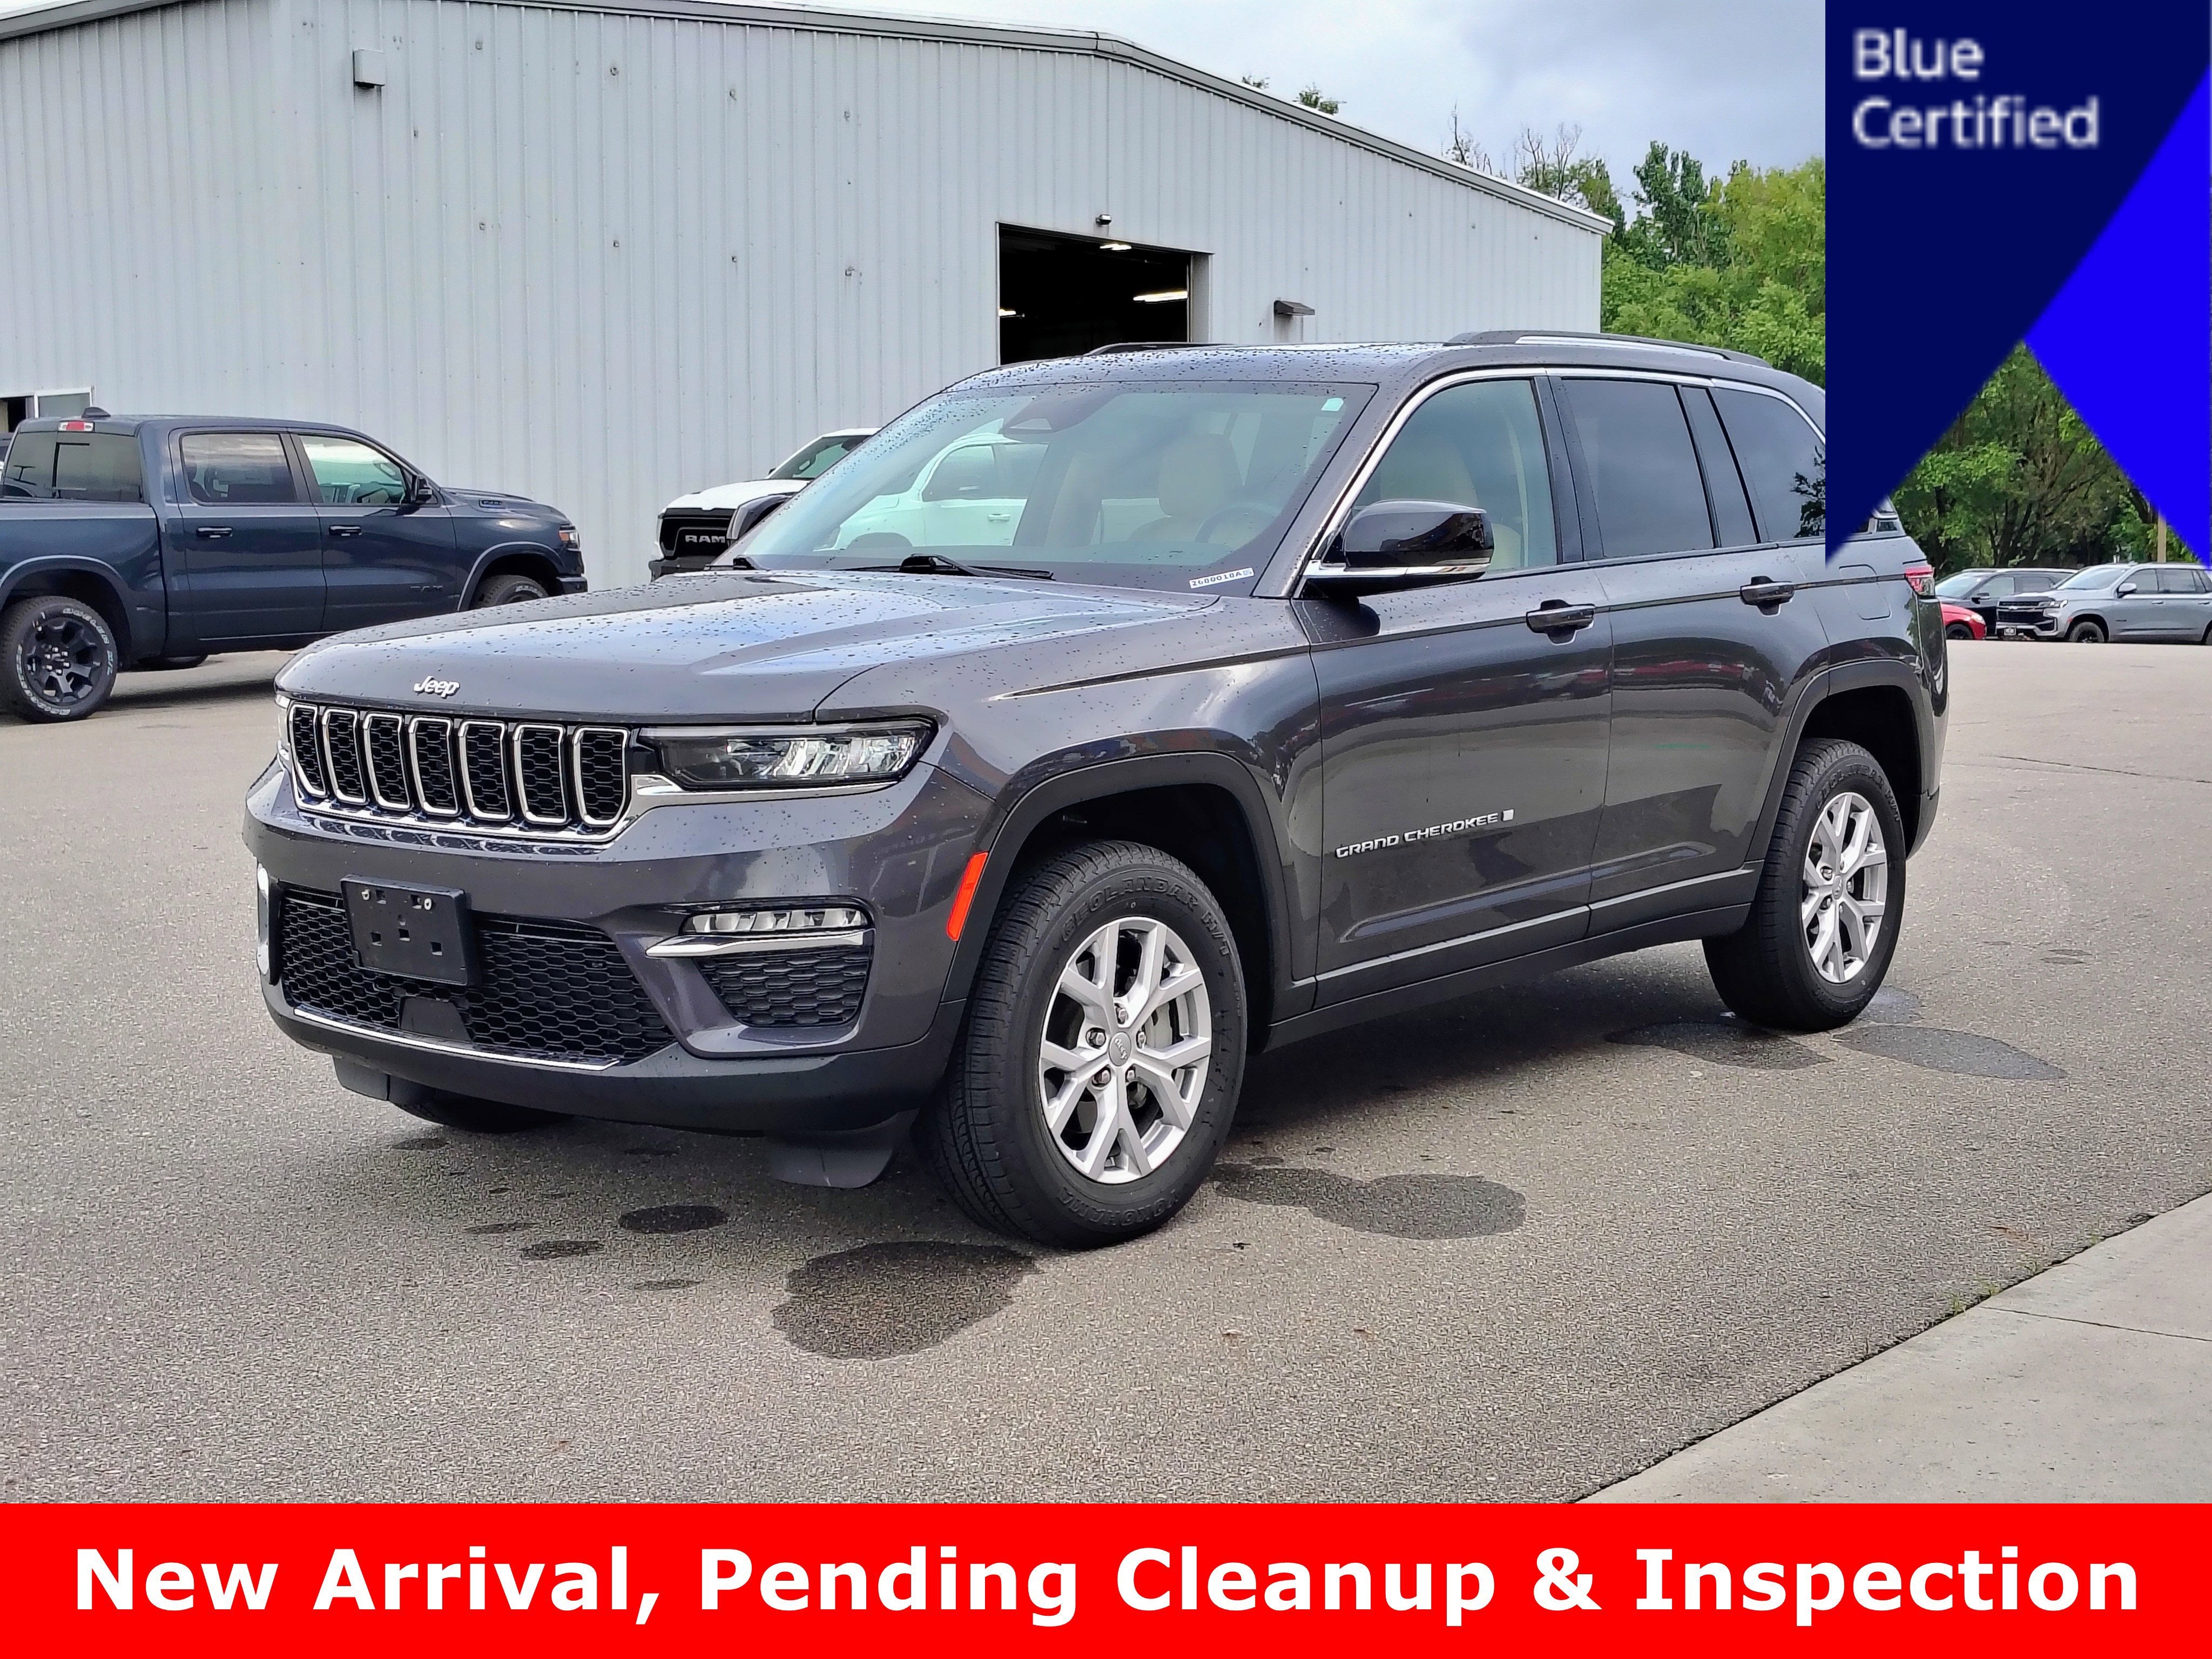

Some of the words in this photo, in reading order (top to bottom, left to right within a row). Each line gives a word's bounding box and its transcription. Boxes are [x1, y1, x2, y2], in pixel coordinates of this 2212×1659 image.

[685, 535, 725, 543] RAM
[414, 676, 460, 698] Jeep
[1336, 834, 1399, 859] GRAND
[1404, 813, 1499, 842] CHEROKEE
